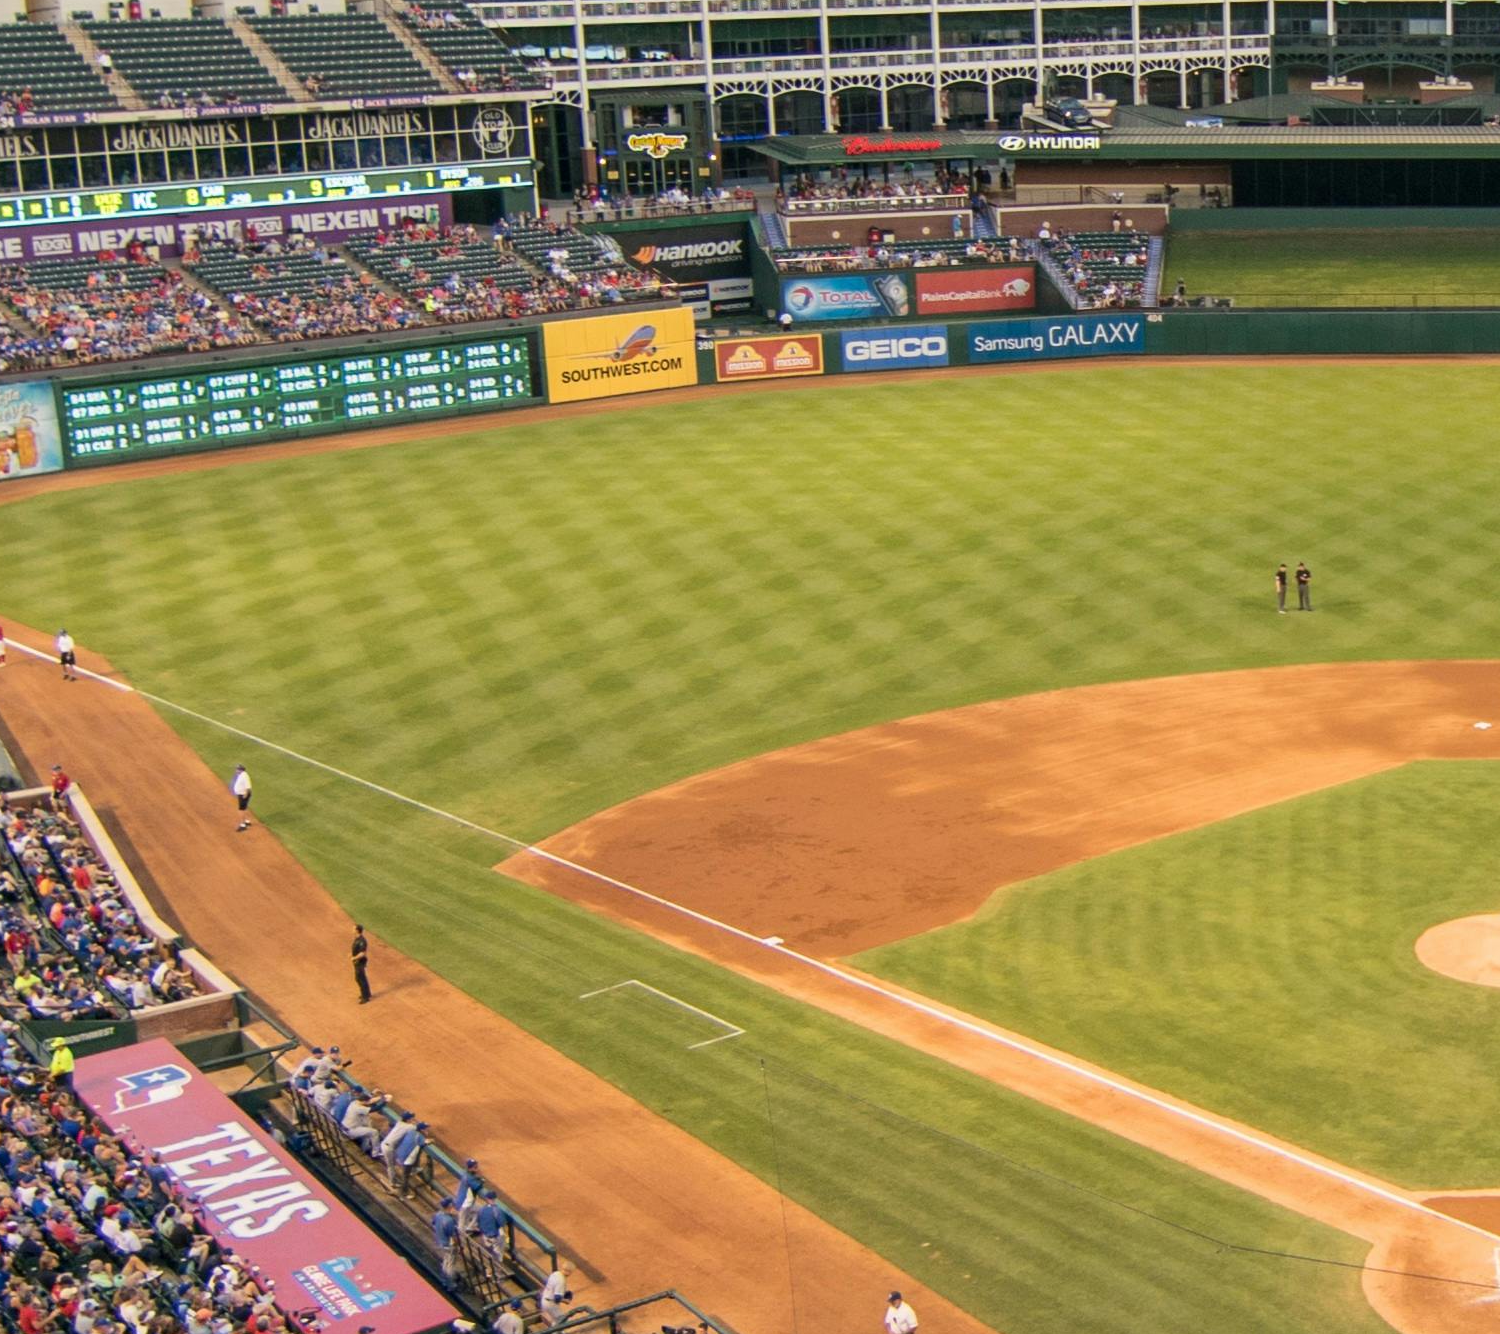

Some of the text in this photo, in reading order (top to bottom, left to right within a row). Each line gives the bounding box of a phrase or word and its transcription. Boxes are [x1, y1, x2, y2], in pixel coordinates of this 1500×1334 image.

[0, 115, 76, 128] 34 NOLAN RYAN
[310, 114, 353, 139] JACK
[484, 113, 501, 121] OLD
[114, 125, 164, 151] JACK
[1028, 136, 1100, 149] HYUNDAI
[133, 192, 157, 210] KC
[291, 209, 378, 234] NEXEN
[78, 222, 175, 254] NEXEN
[820, 291, 873, 303] TOTAL
[845, 336, 947, 361] GEICO
[974, 322, 1139, 352] Samsung GALAXY
[562, 356, 682, 384] SOUTHWEST.COM
[152, 1121, 330, 1239] TEXAS
